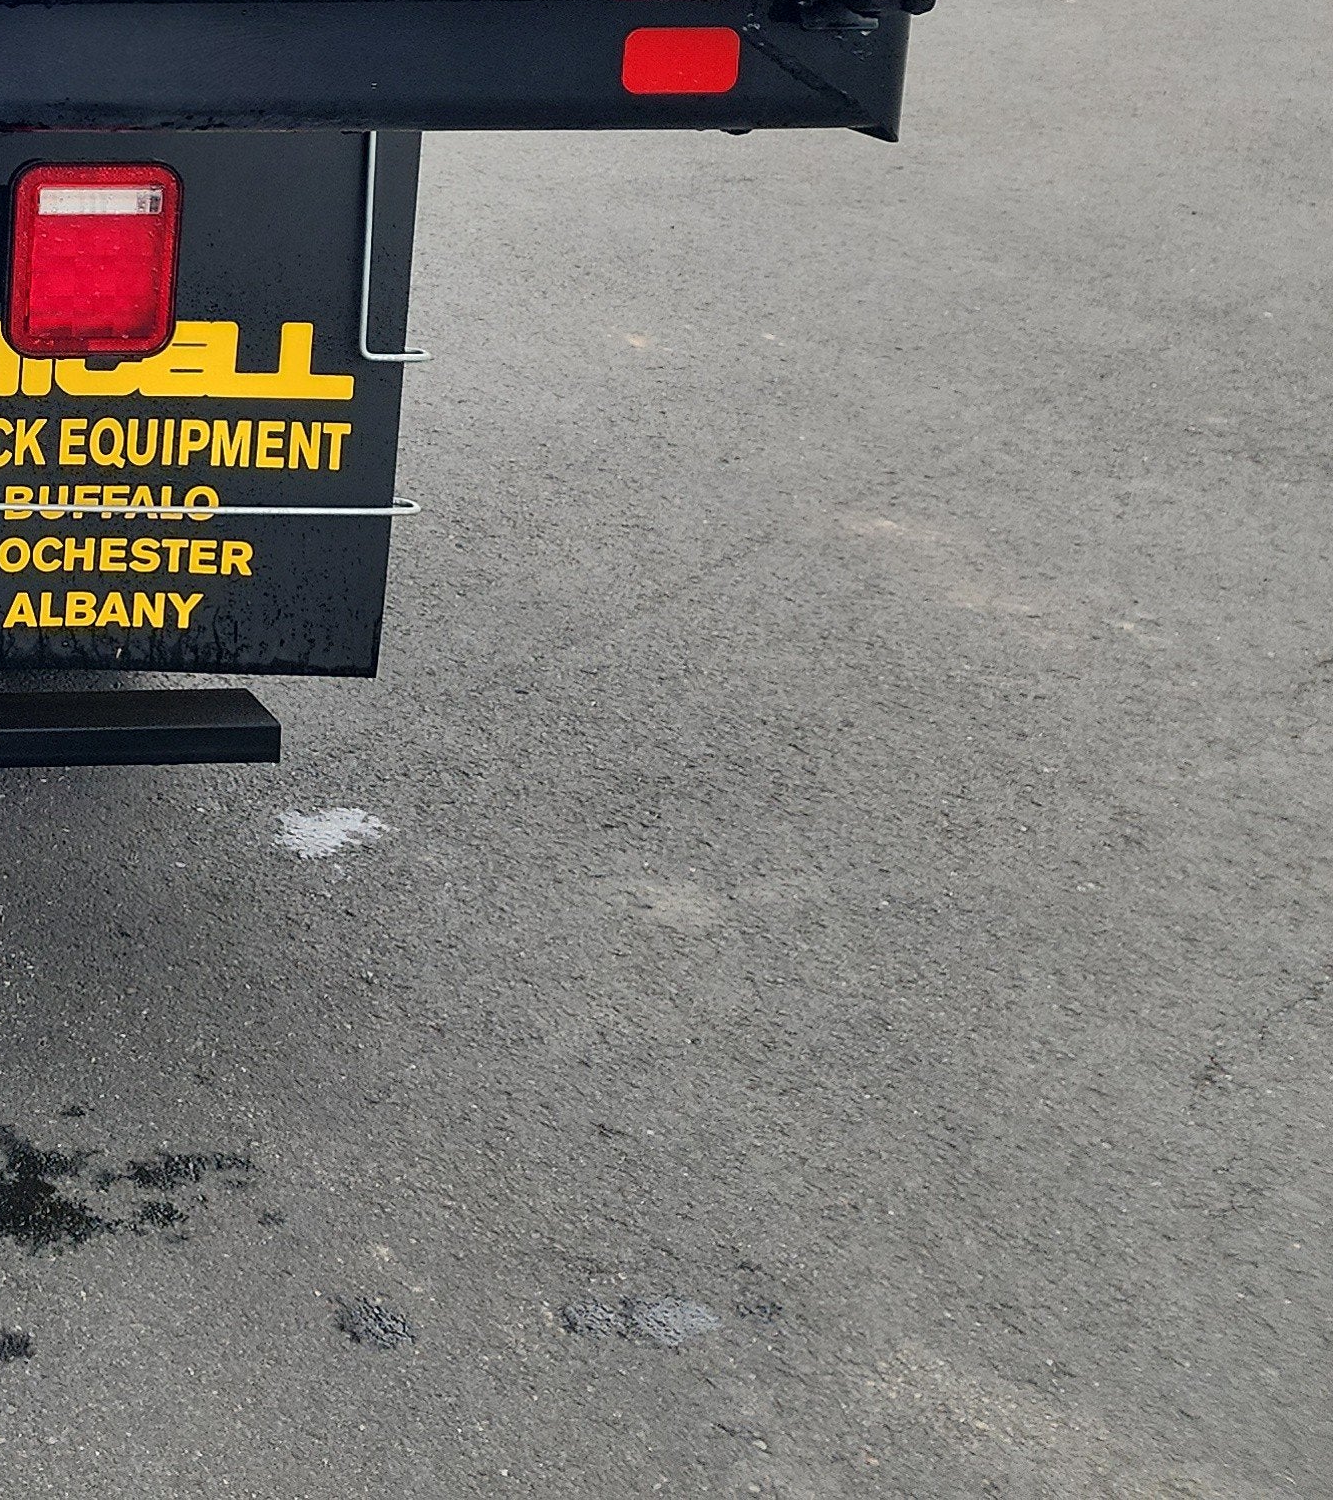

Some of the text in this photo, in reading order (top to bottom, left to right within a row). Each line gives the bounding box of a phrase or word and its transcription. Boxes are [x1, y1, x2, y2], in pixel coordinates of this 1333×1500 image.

[58, 417, 352, 471] EQUIPMENT
[4, 484, 220, 521] BUFFALO
[2, 591, 203, 629] ALBANY
